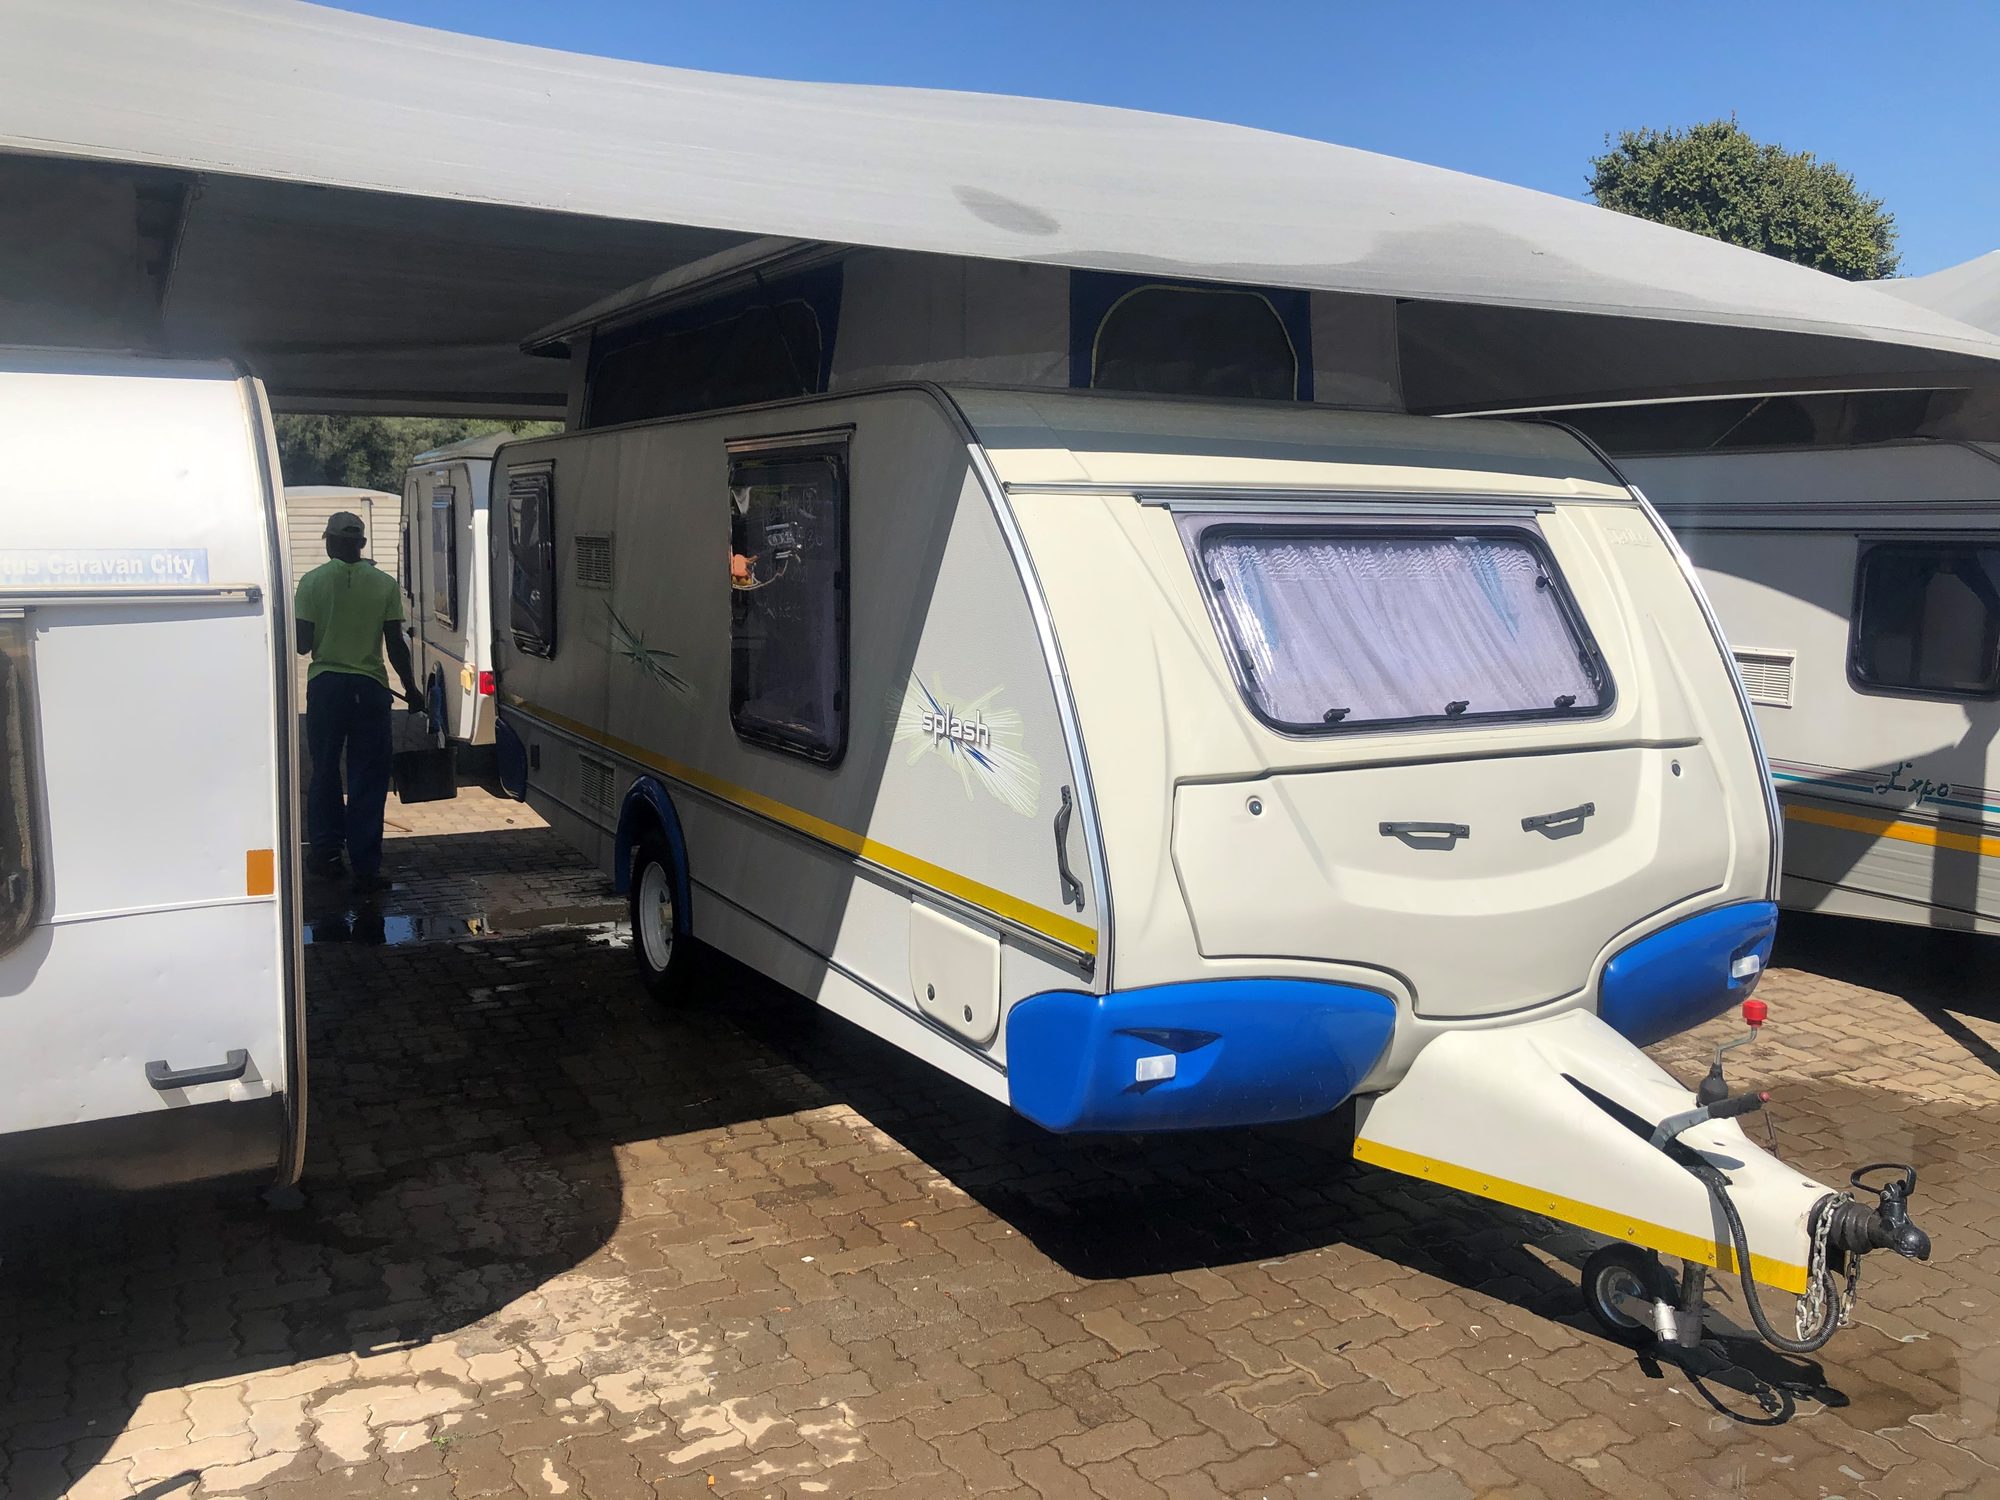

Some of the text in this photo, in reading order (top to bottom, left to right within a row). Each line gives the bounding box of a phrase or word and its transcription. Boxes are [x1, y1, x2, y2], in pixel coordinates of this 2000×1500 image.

[47, 554, 144, 575] Caravan
[150, 552, 195, 578] City
[921, 703, 990, 746] splash
[1874, 761, 1949, 806] Expo
